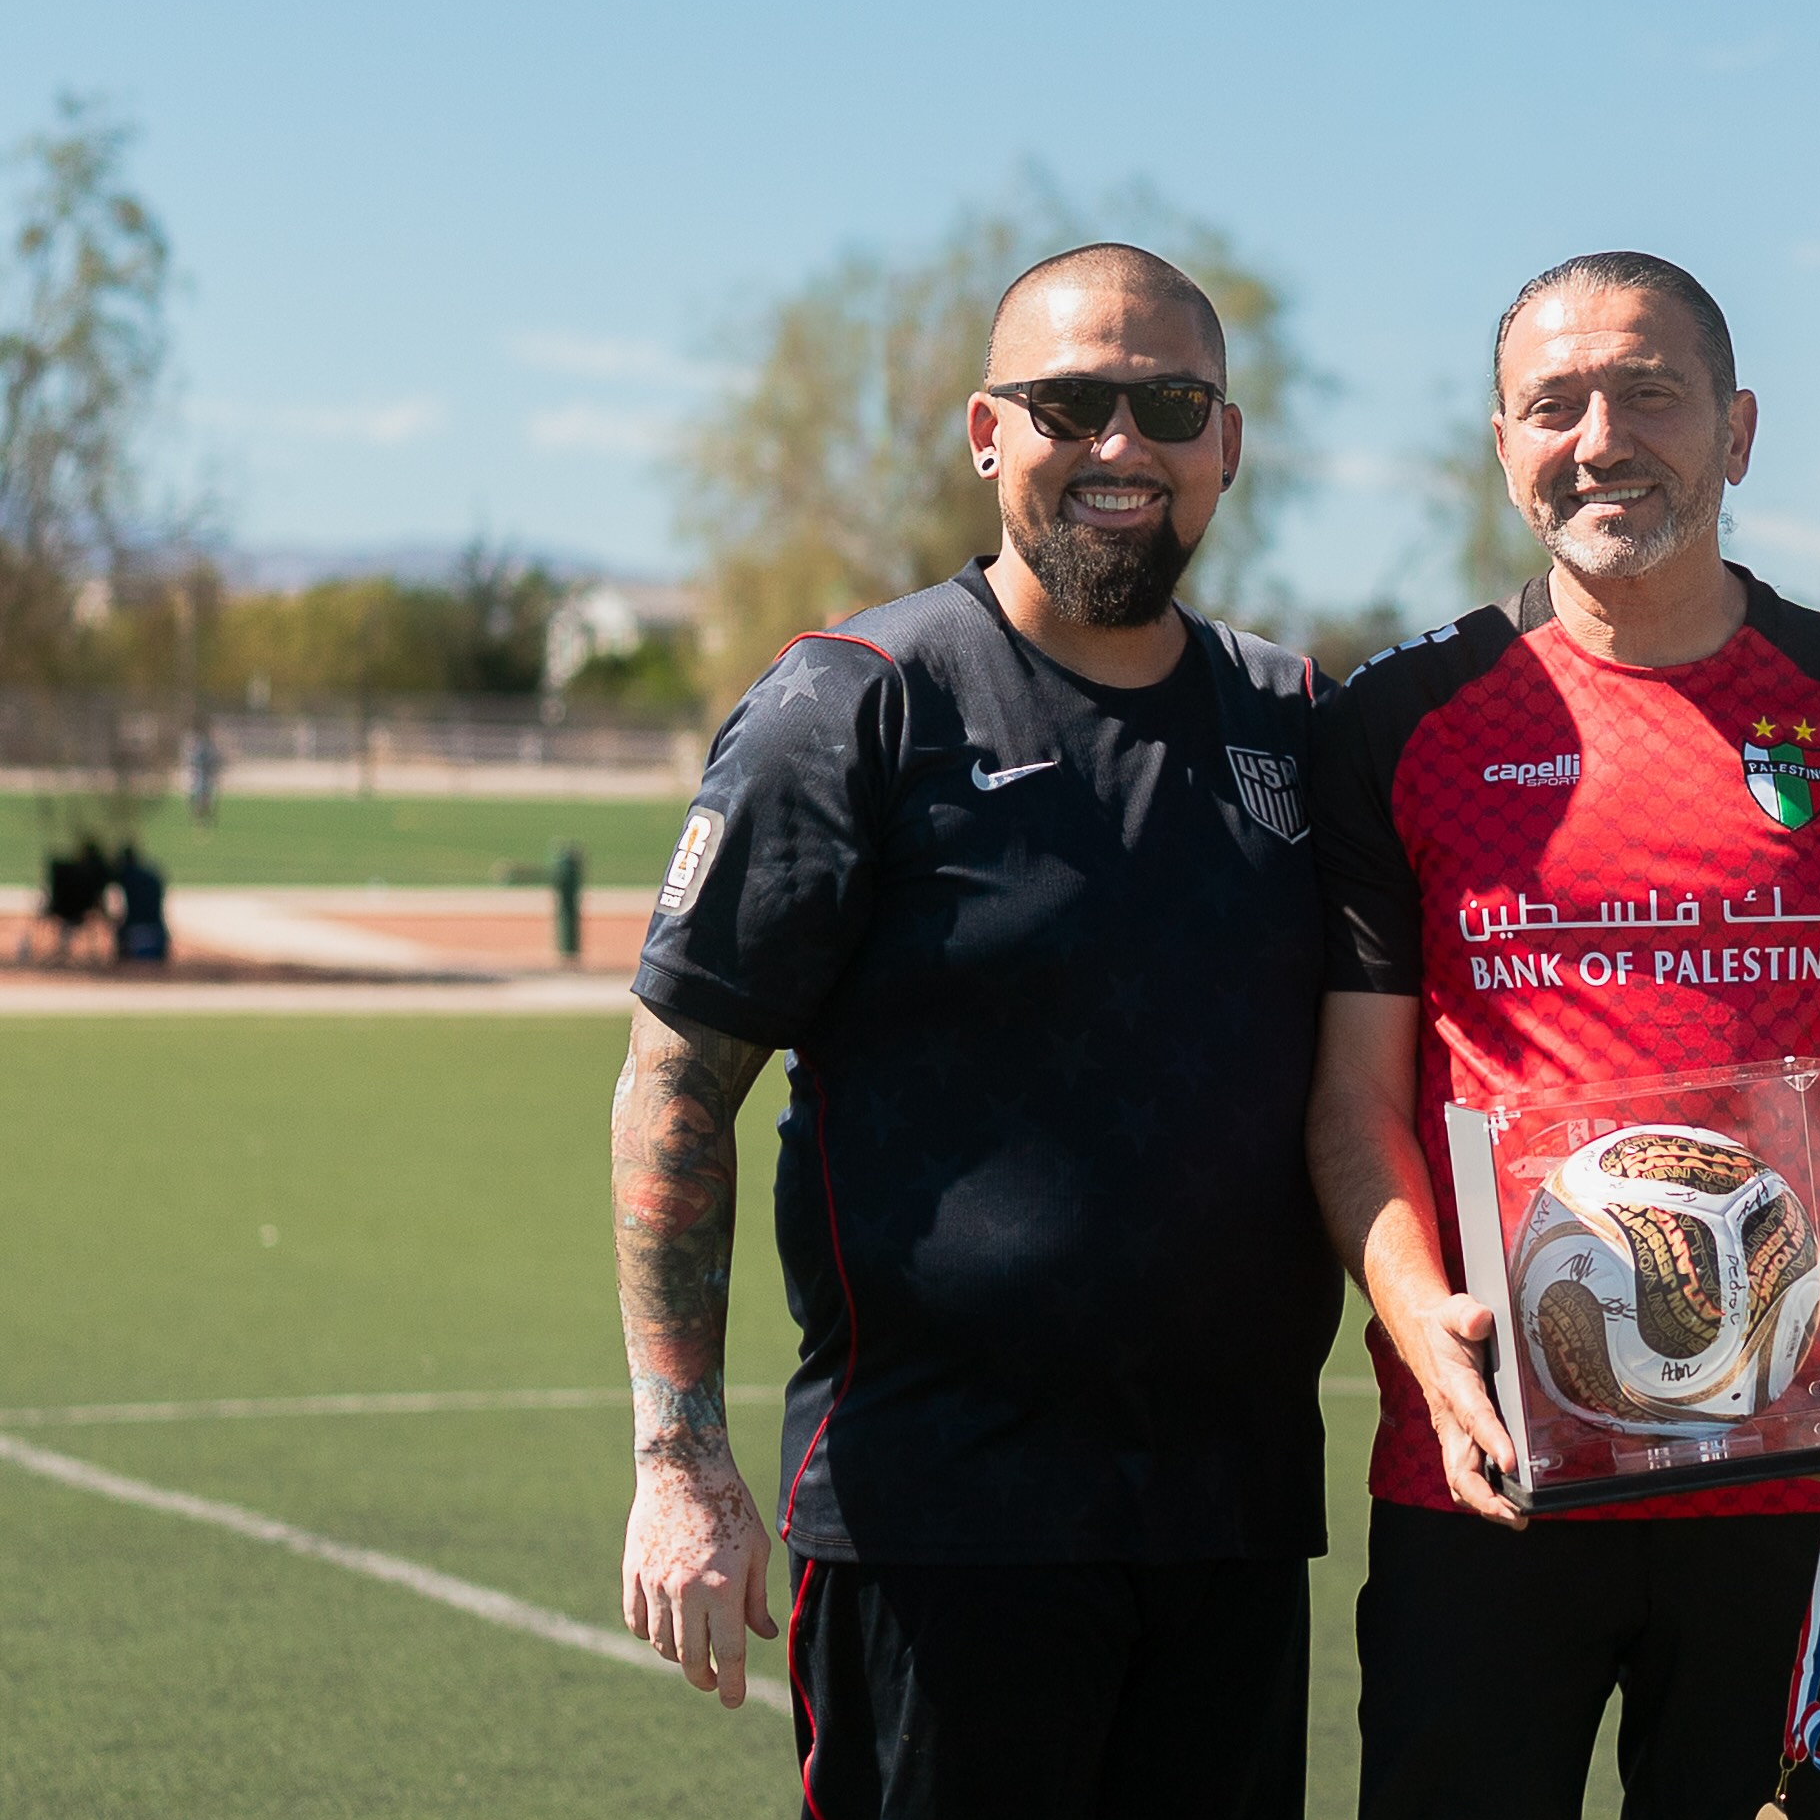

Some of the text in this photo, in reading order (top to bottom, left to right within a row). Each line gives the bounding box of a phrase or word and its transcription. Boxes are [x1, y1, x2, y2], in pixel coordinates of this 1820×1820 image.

[1236, 753, 1297, 789] USA
[1483, 753, 1580, 785] capelli
[1526, 776, 1580, 787] SPORT
[1459, 889, 1699, 943] فلسطين
[1470, 952, 1564, 990] BANK
[1579, 951, 1633, 987] OF
[1647, 1205, 1726, 1321] ATLANTA
